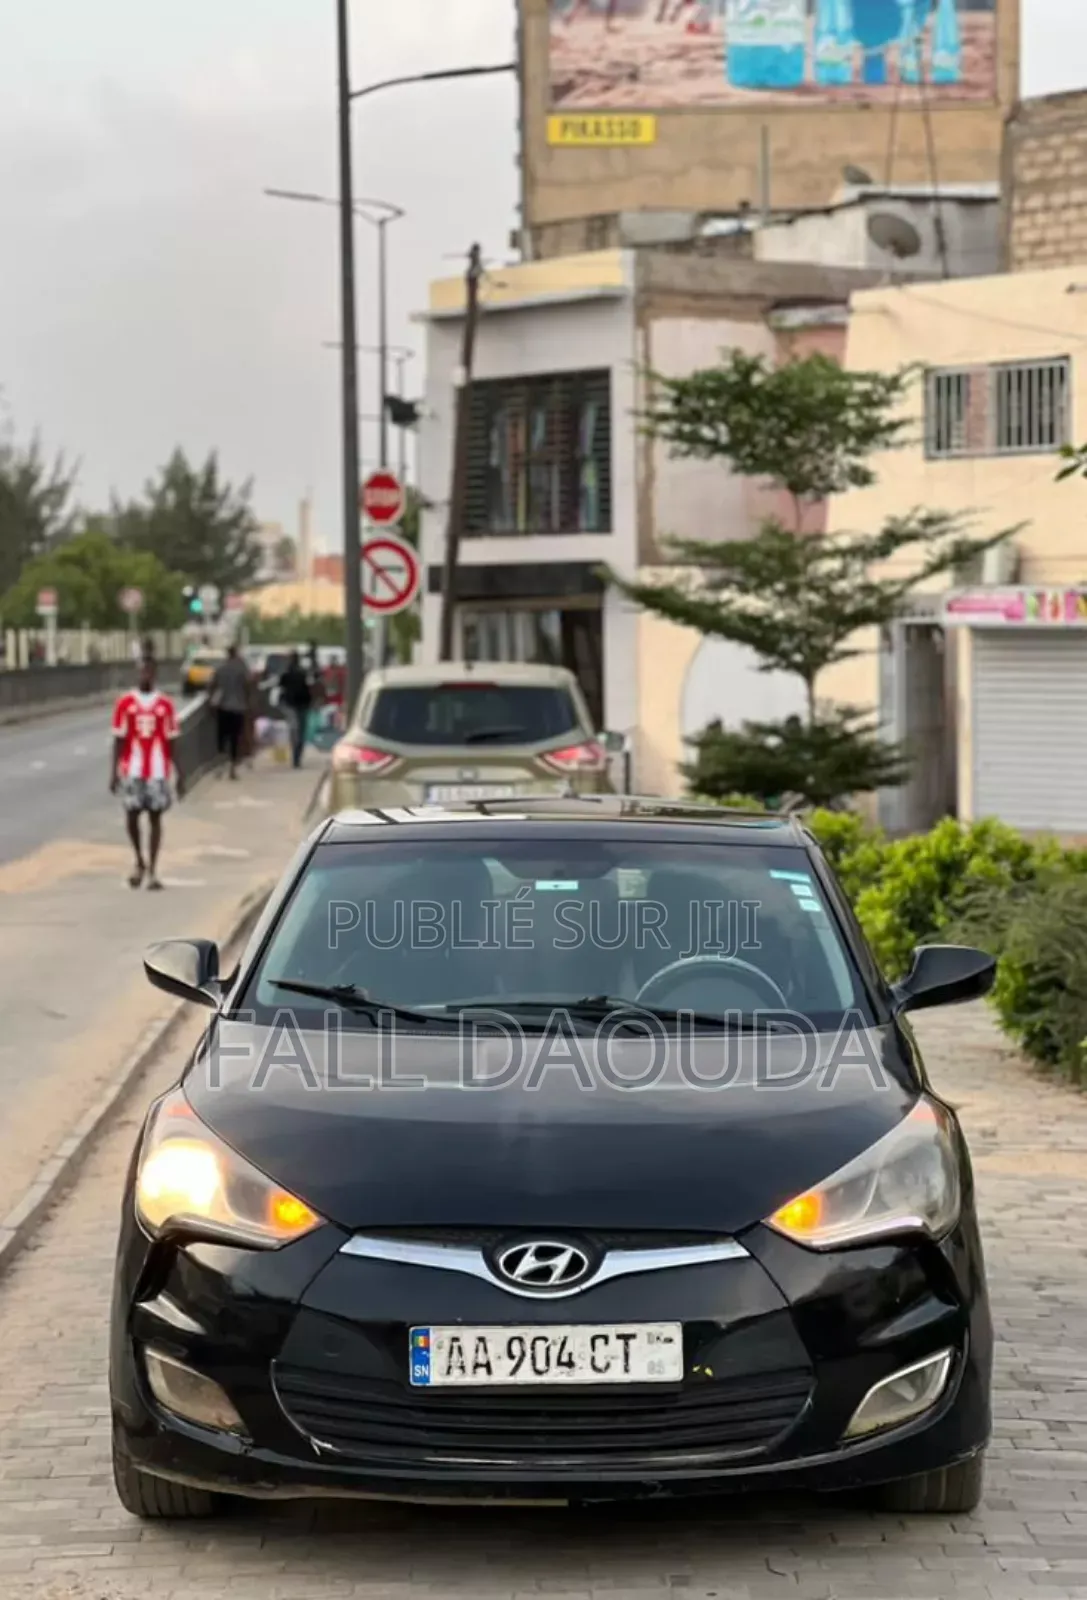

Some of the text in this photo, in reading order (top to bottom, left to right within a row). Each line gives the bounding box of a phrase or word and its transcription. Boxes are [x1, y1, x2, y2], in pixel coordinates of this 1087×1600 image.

[446, 1333, 637, 1376] AA 904 CT
[414, 1364, 429, 1377] SN
